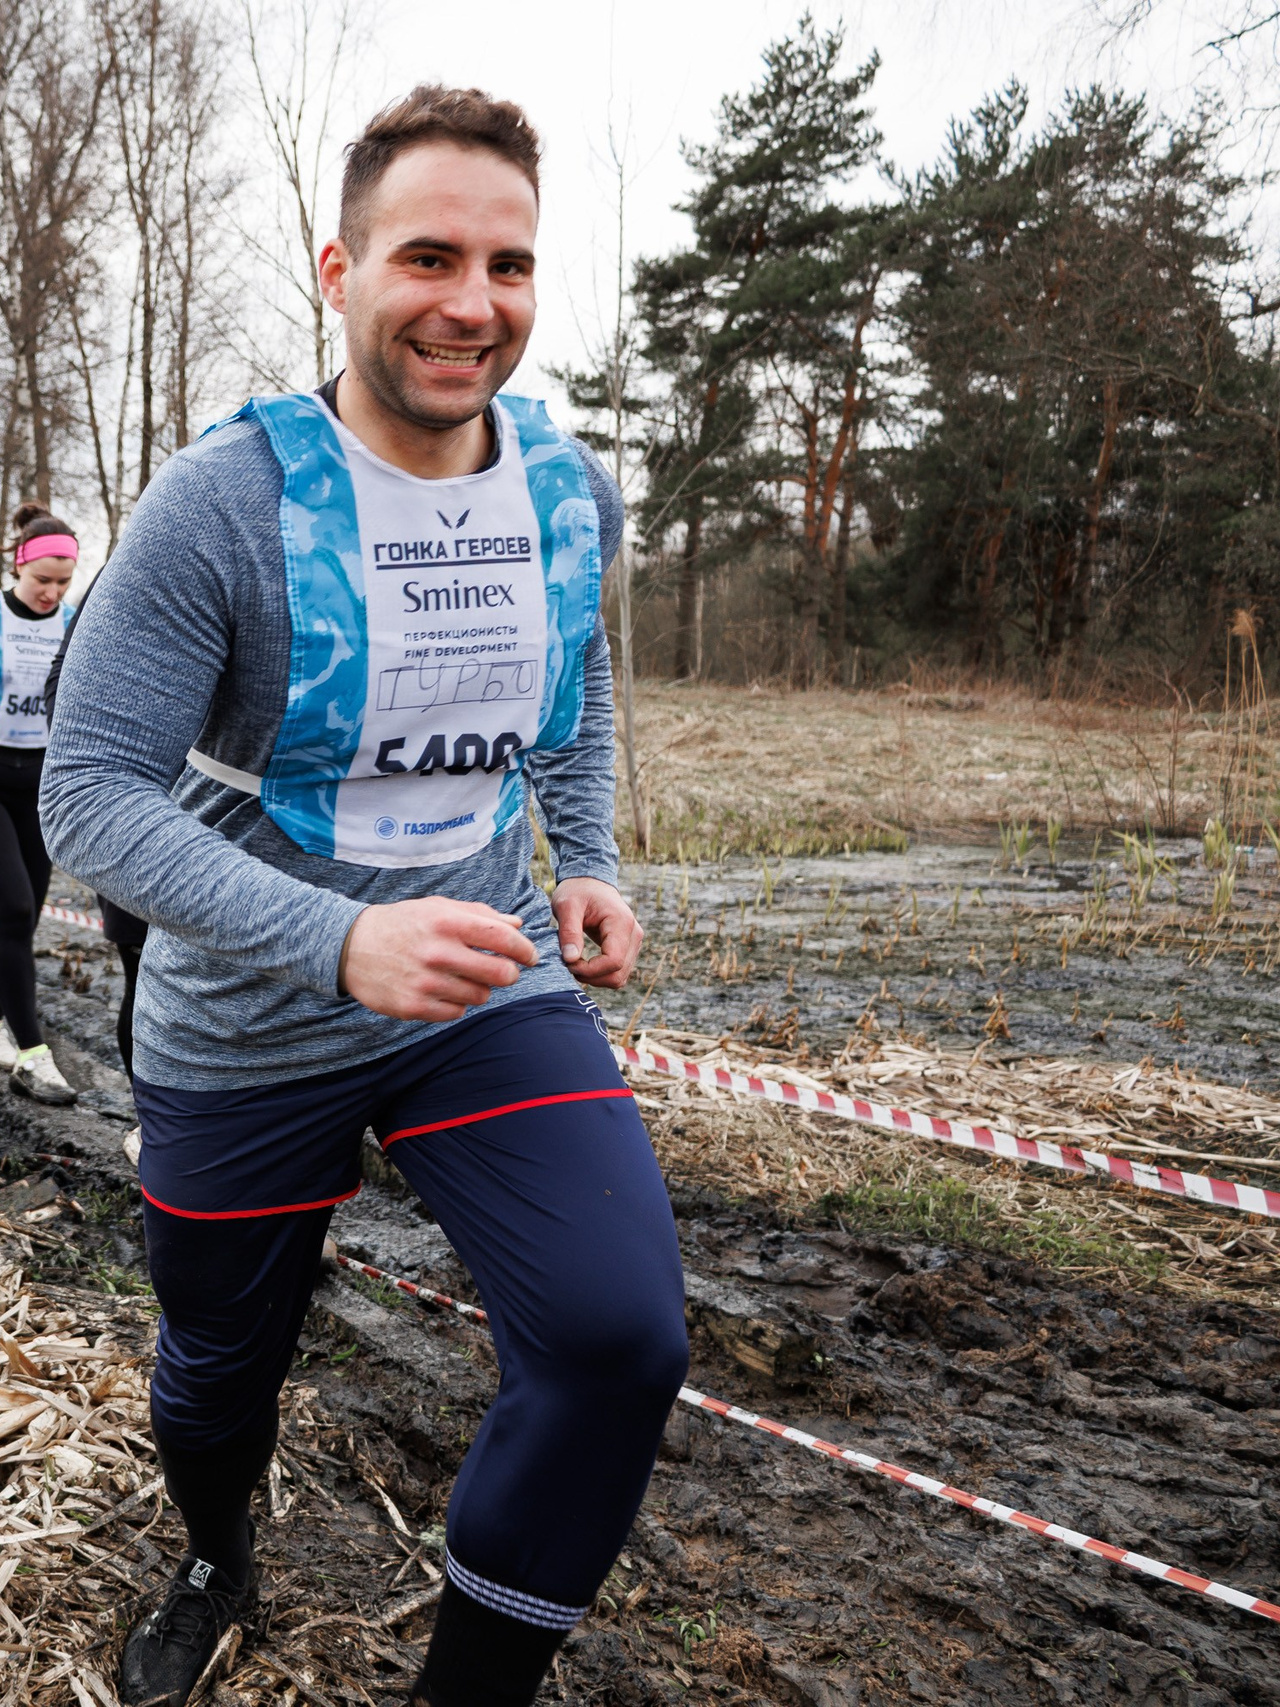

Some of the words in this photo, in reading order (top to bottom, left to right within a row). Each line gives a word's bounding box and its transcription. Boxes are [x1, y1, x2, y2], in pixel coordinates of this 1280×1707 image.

[373, 540, 449, 562] ГОНКА
[455, 536, 532, 558] ГЕРОЕВ
[402, 578, 516, 614] Sminex
[404, 625, 518, 643] ПЕРФЕКЦИОНИСТЫ
[404, 648, 430, 660] FINE
[434, 642, 518, 657] DEVELOPMENT
[403, 811, 476, 836] ГАЗПРОМБАНК
